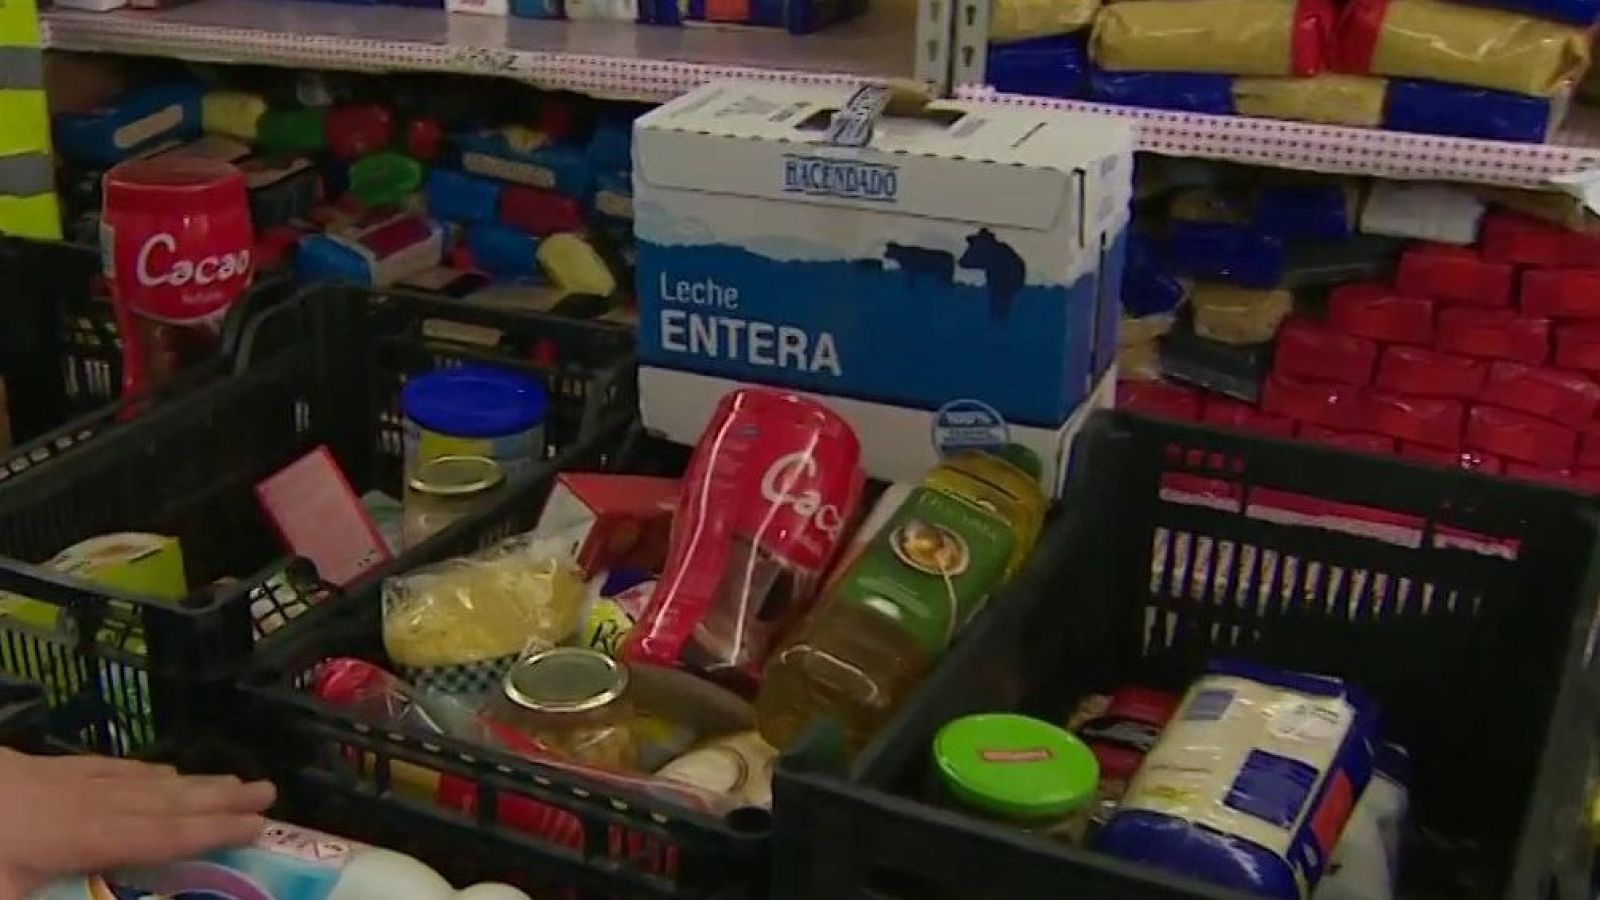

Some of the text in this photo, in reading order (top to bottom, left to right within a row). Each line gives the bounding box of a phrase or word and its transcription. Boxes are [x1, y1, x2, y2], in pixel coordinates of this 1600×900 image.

[784, 159, 899, 200] HACENDADO
[136, 232, 250, 287] Cacao
[660, 271, 739, 309] Leche
[660, 309, 841, 376] ENTERA
